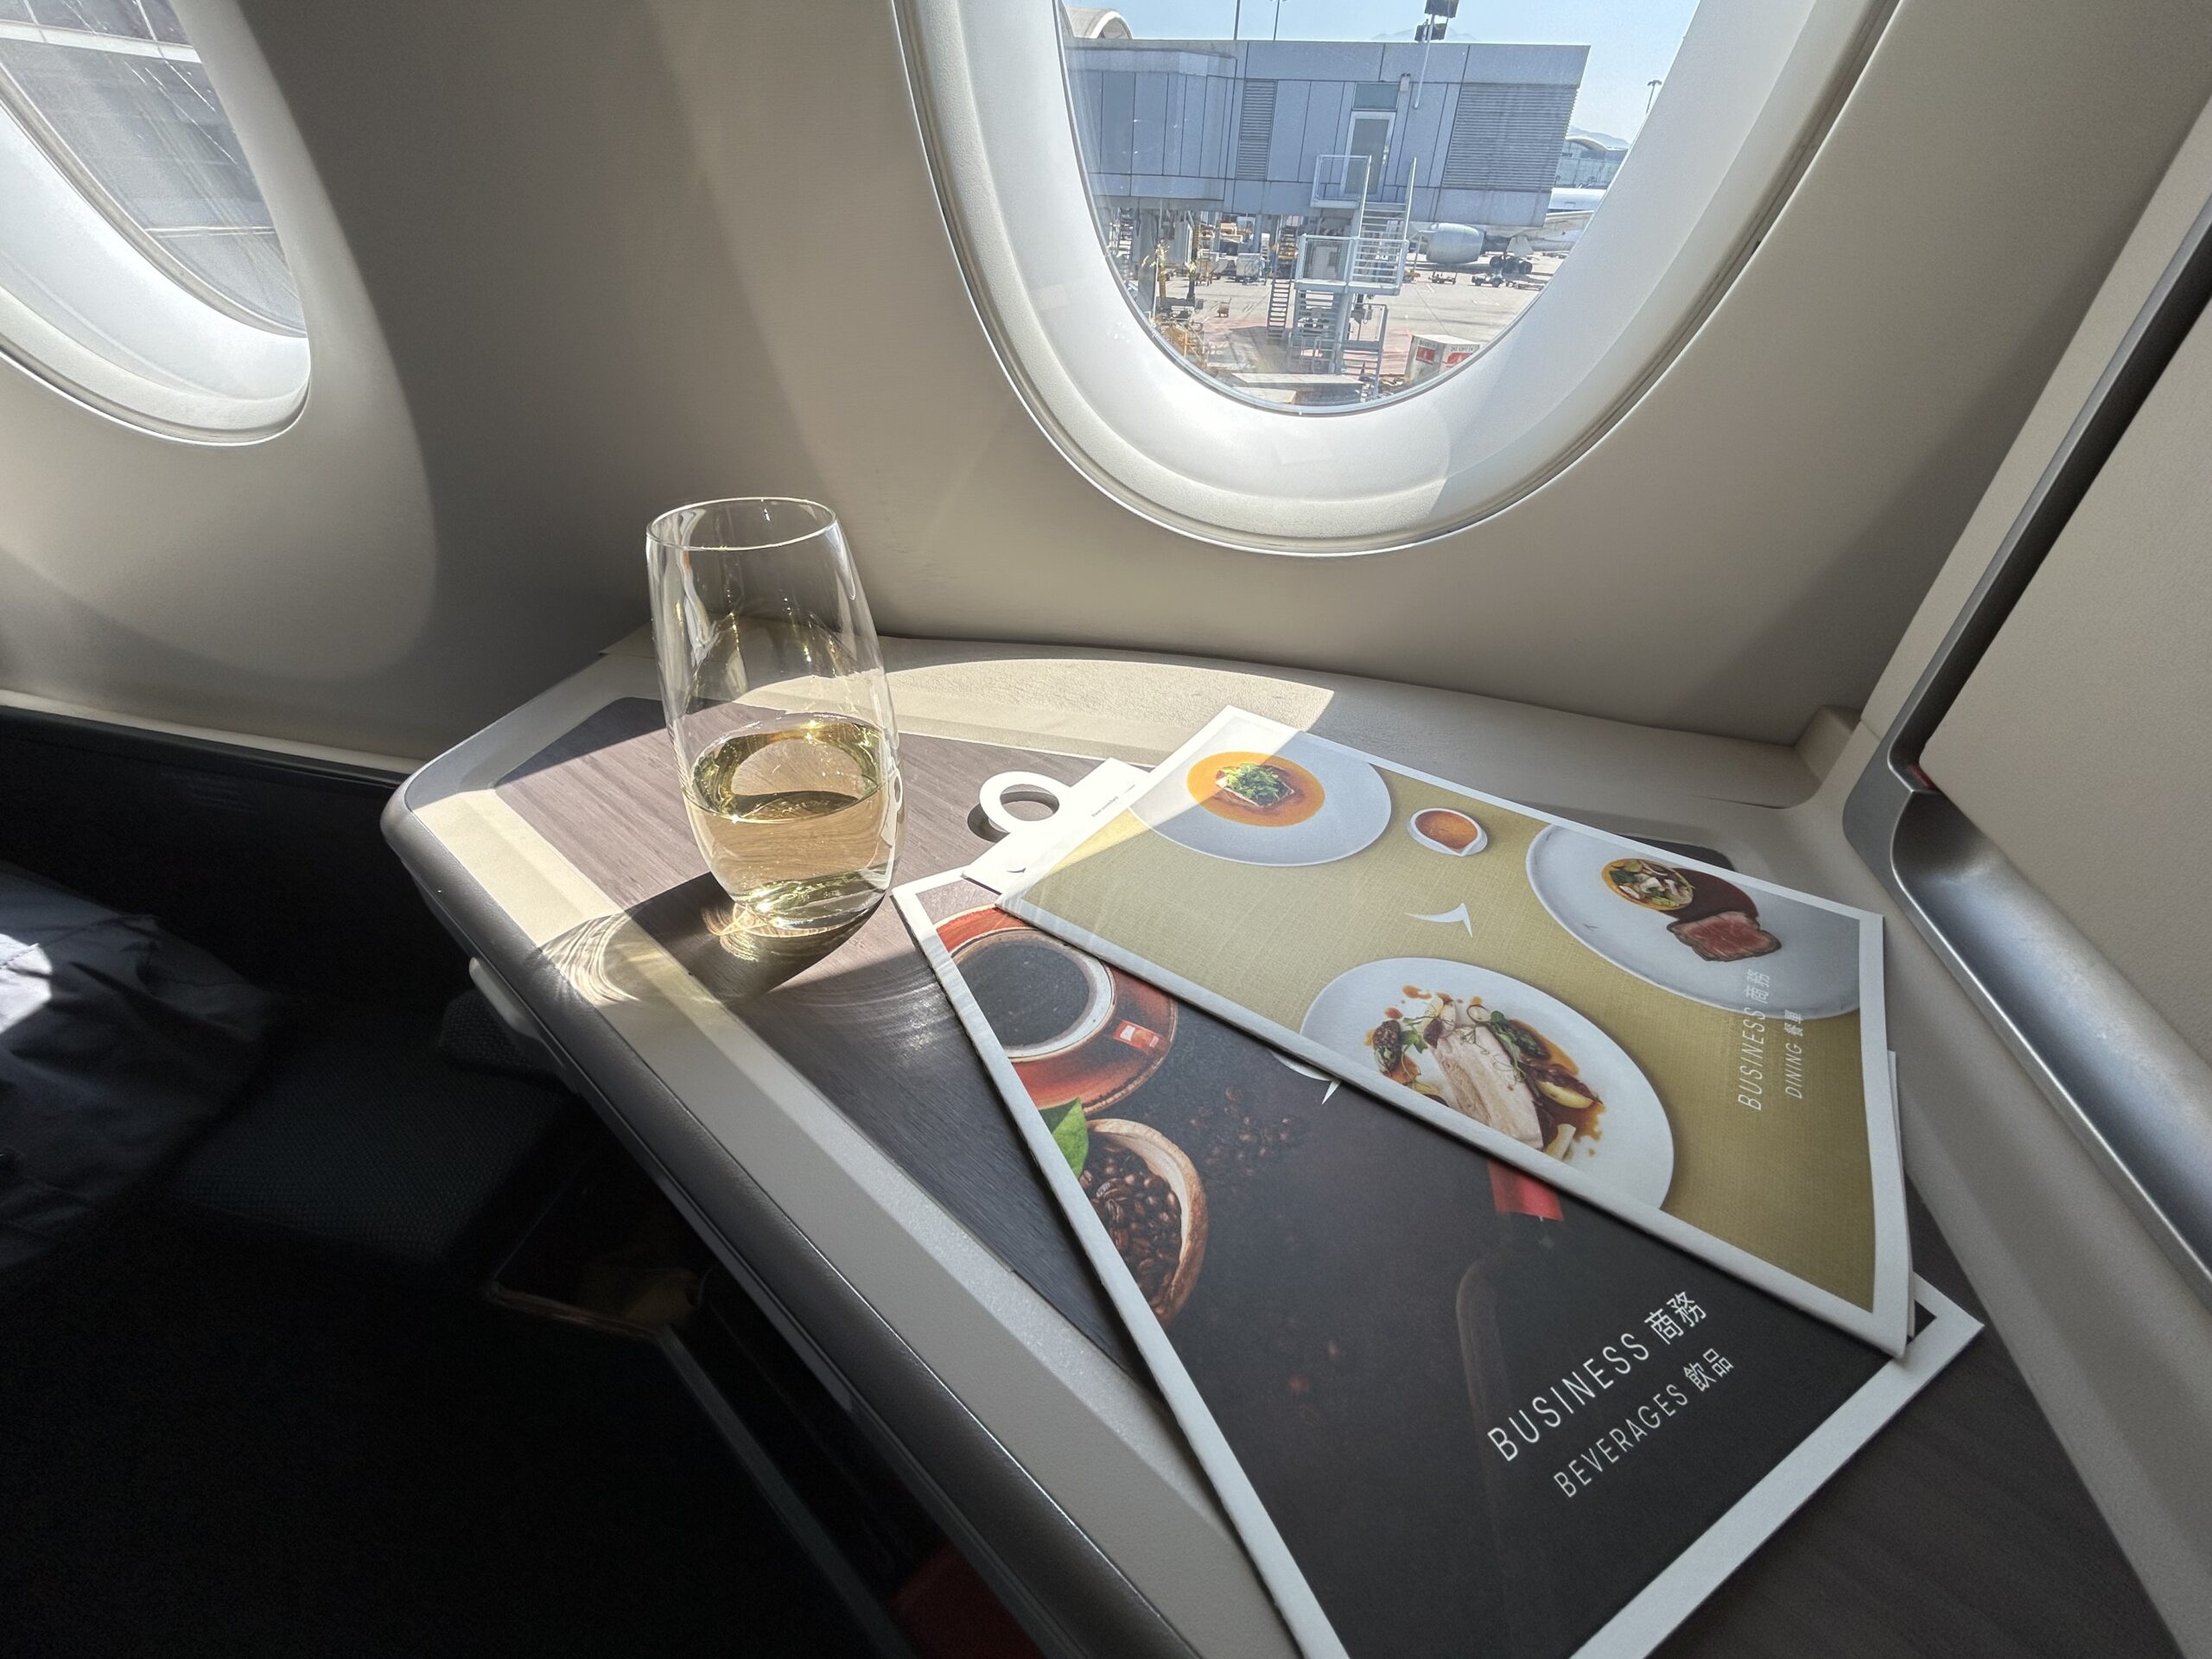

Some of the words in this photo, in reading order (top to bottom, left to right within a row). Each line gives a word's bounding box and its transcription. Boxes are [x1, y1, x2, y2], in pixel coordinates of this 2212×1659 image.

[1738, 1007, 1766, 1111] BUSINESS
[1785, 1043, 1802, 1100] DINING
[1487, 1332, 1649, 1462] BUSINESS
[1644, 1291, 1707, 1344] 商務
[1554, 1384, 1688, 1498] BEVERAGES
[1683, 1348, 1734, 1392] 飲品
